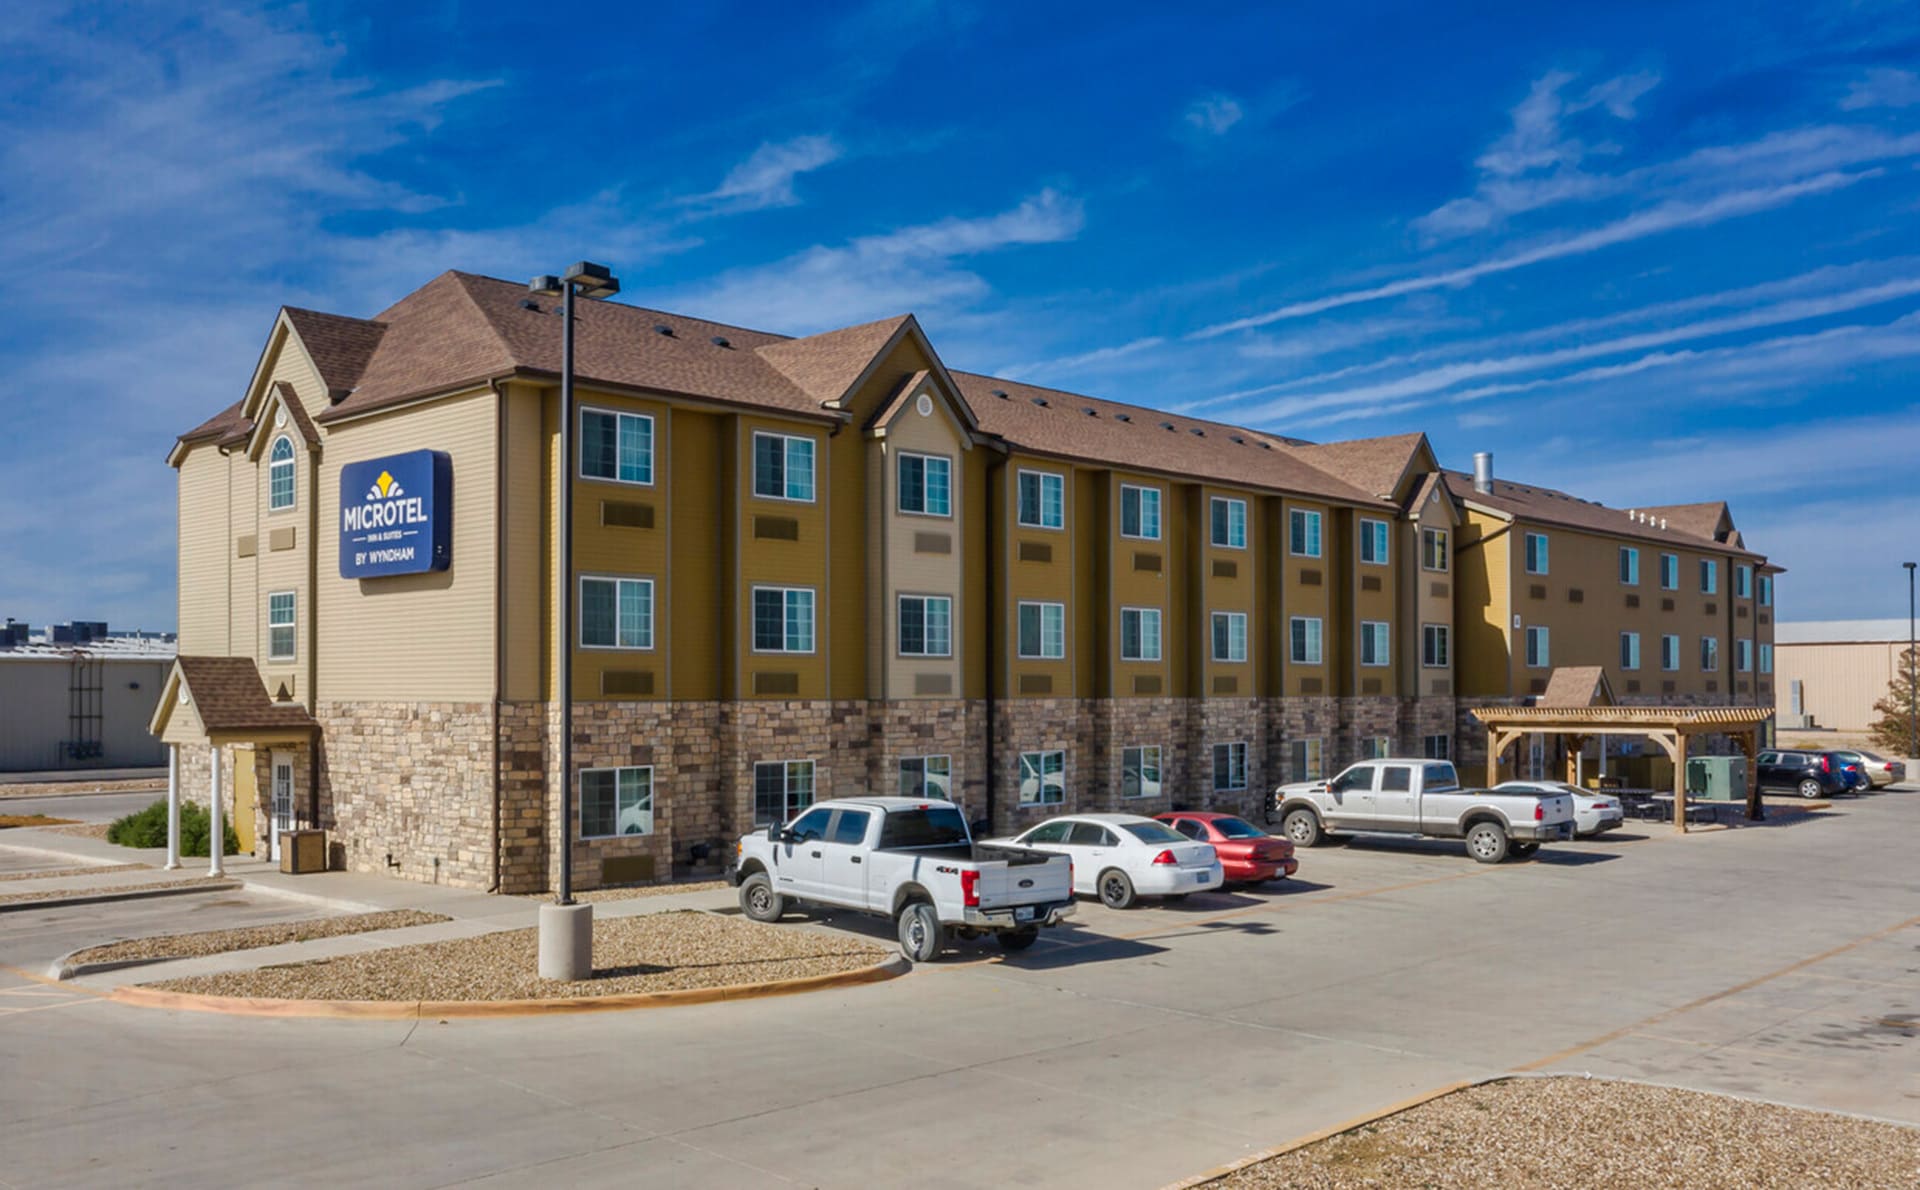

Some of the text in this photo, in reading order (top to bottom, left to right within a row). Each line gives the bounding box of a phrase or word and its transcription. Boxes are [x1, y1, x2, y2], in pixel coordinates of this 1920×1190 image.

[344, 497, 428, 532] MICROTEL
[355, 547, 415, 566] BY WYNDHAM
